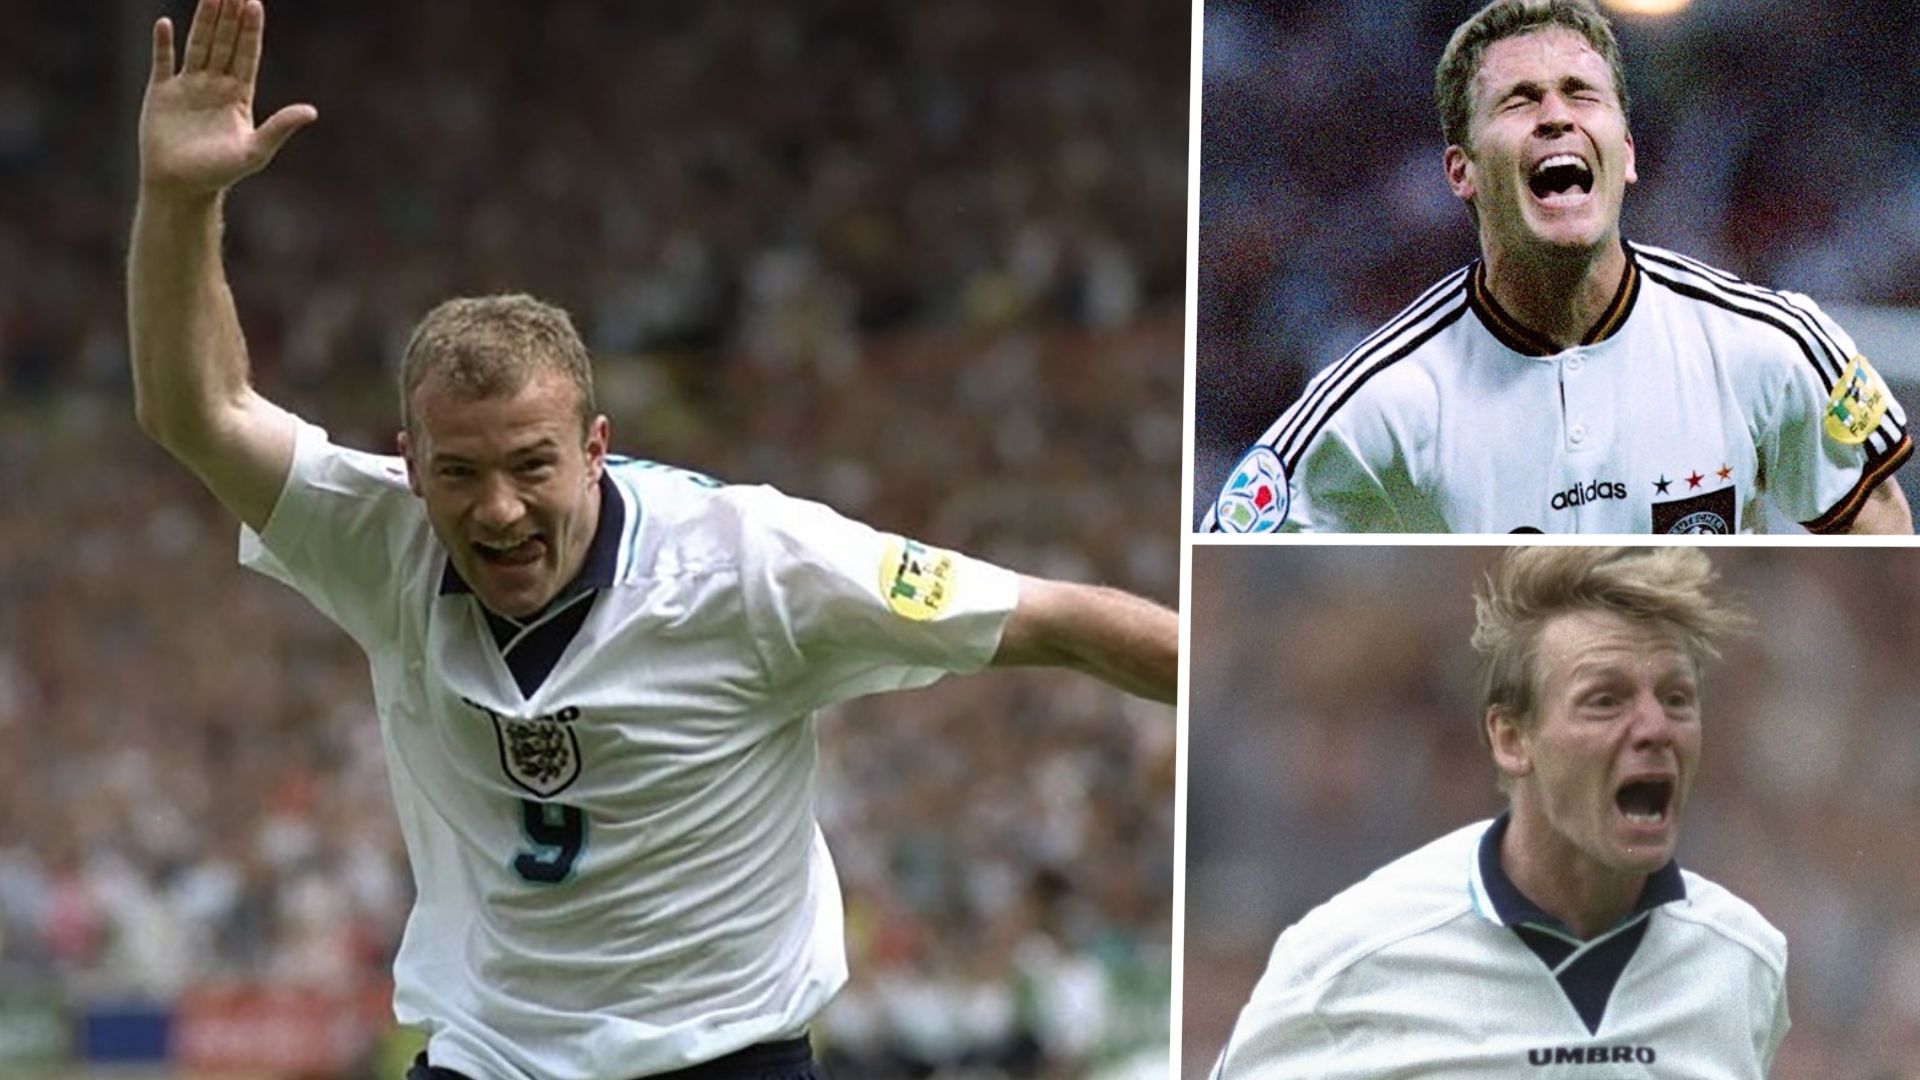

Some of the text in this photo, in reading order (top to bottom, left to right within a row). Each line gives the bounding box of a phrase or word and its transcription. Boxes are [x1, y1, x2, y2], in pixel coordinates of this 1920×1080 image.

[1850, 412, 1869, 437] Fair
[1551, 480, 1628, 510] adidas
[514, 800, 583, 883] 9
[1528, 1046, 1656, 1066] UMBRO
